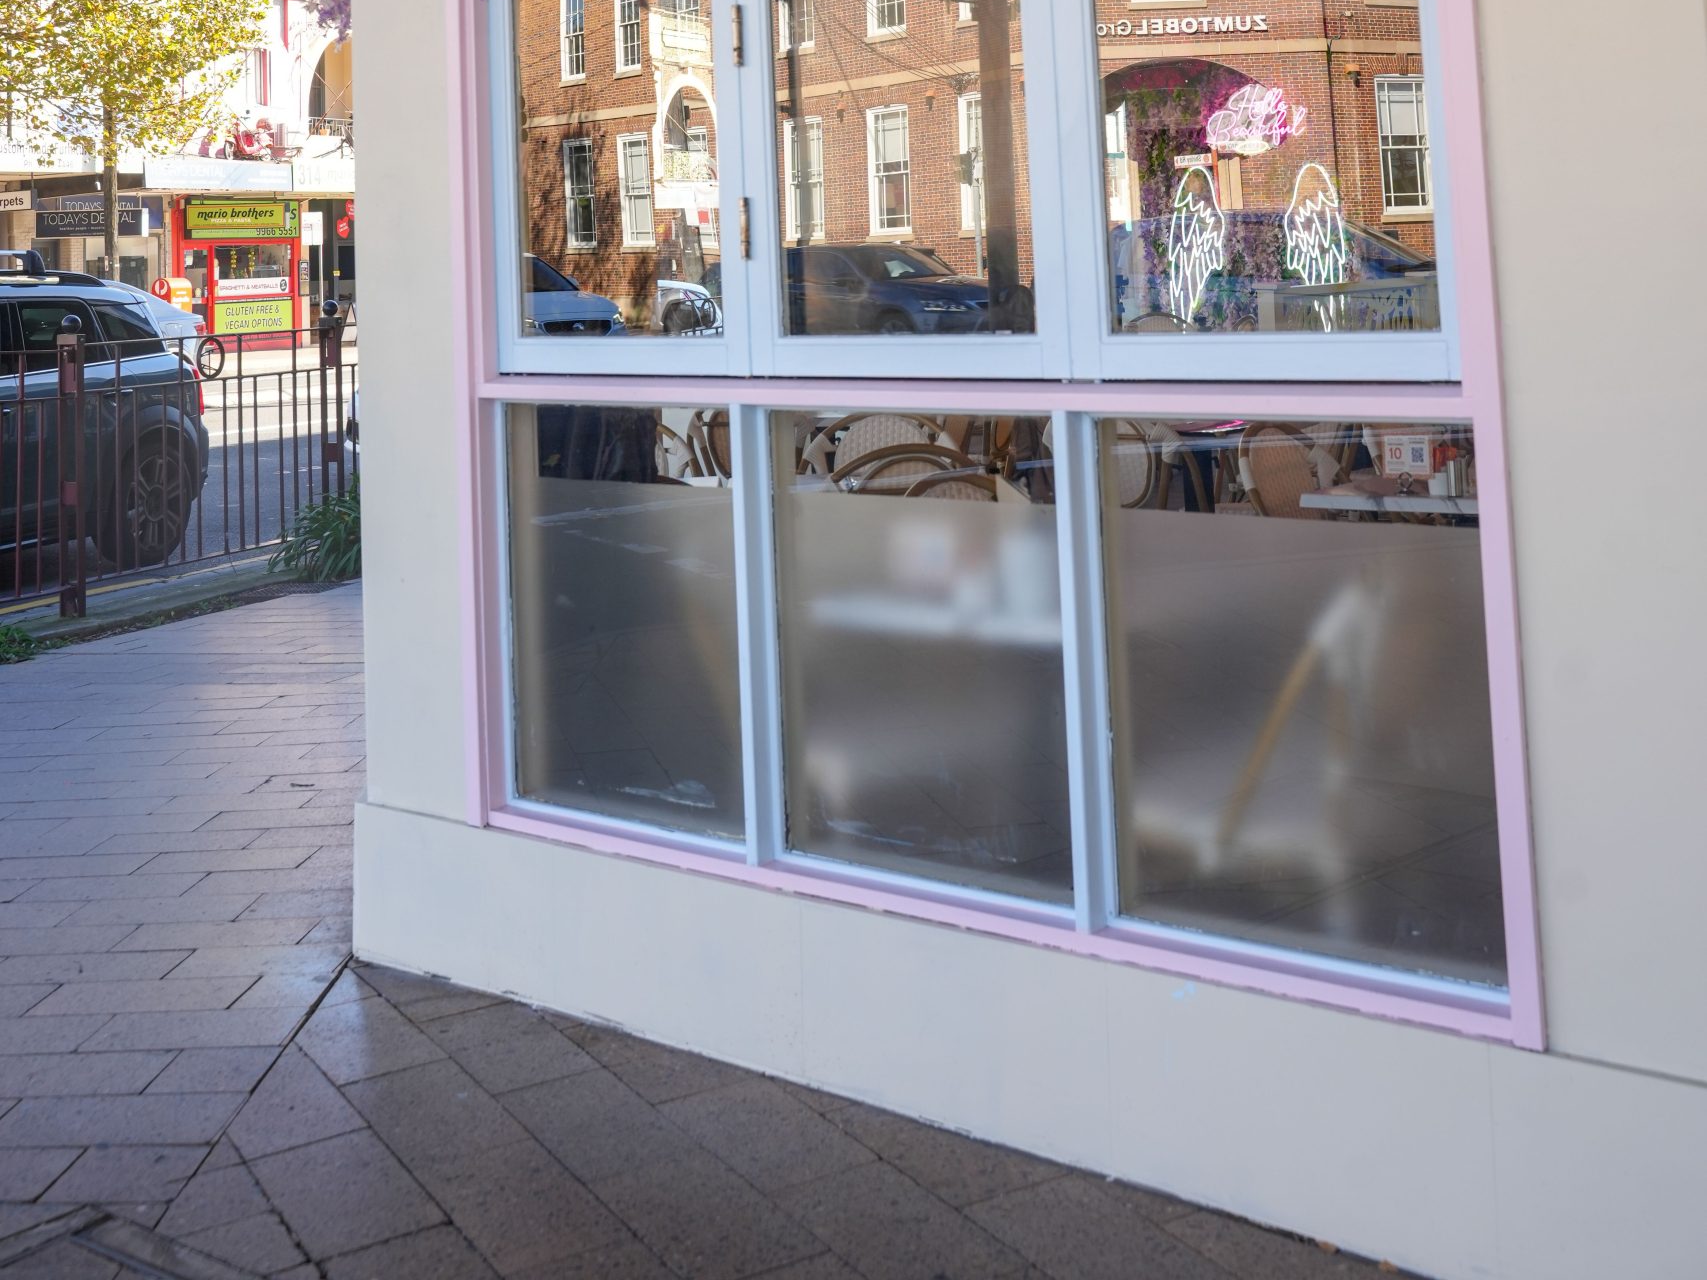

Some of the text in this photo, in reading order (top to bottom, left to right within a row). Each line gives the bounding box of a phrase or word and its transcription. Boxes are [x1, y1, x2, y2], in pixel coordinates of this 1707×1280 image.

[1228, 83, 1288, 122] Hello
[1204, 106, 1308, 145] Beautiful
[43, 212, 135, 225] TODAY'S DETAL
[197, 208, 274, 220] mario brothers
[225, 304, 280, 317] GLUTEN FREE &
[225, 317, 283, 330] VEGAN OPTIONS
[1389, 447, 1402, 460] 10
